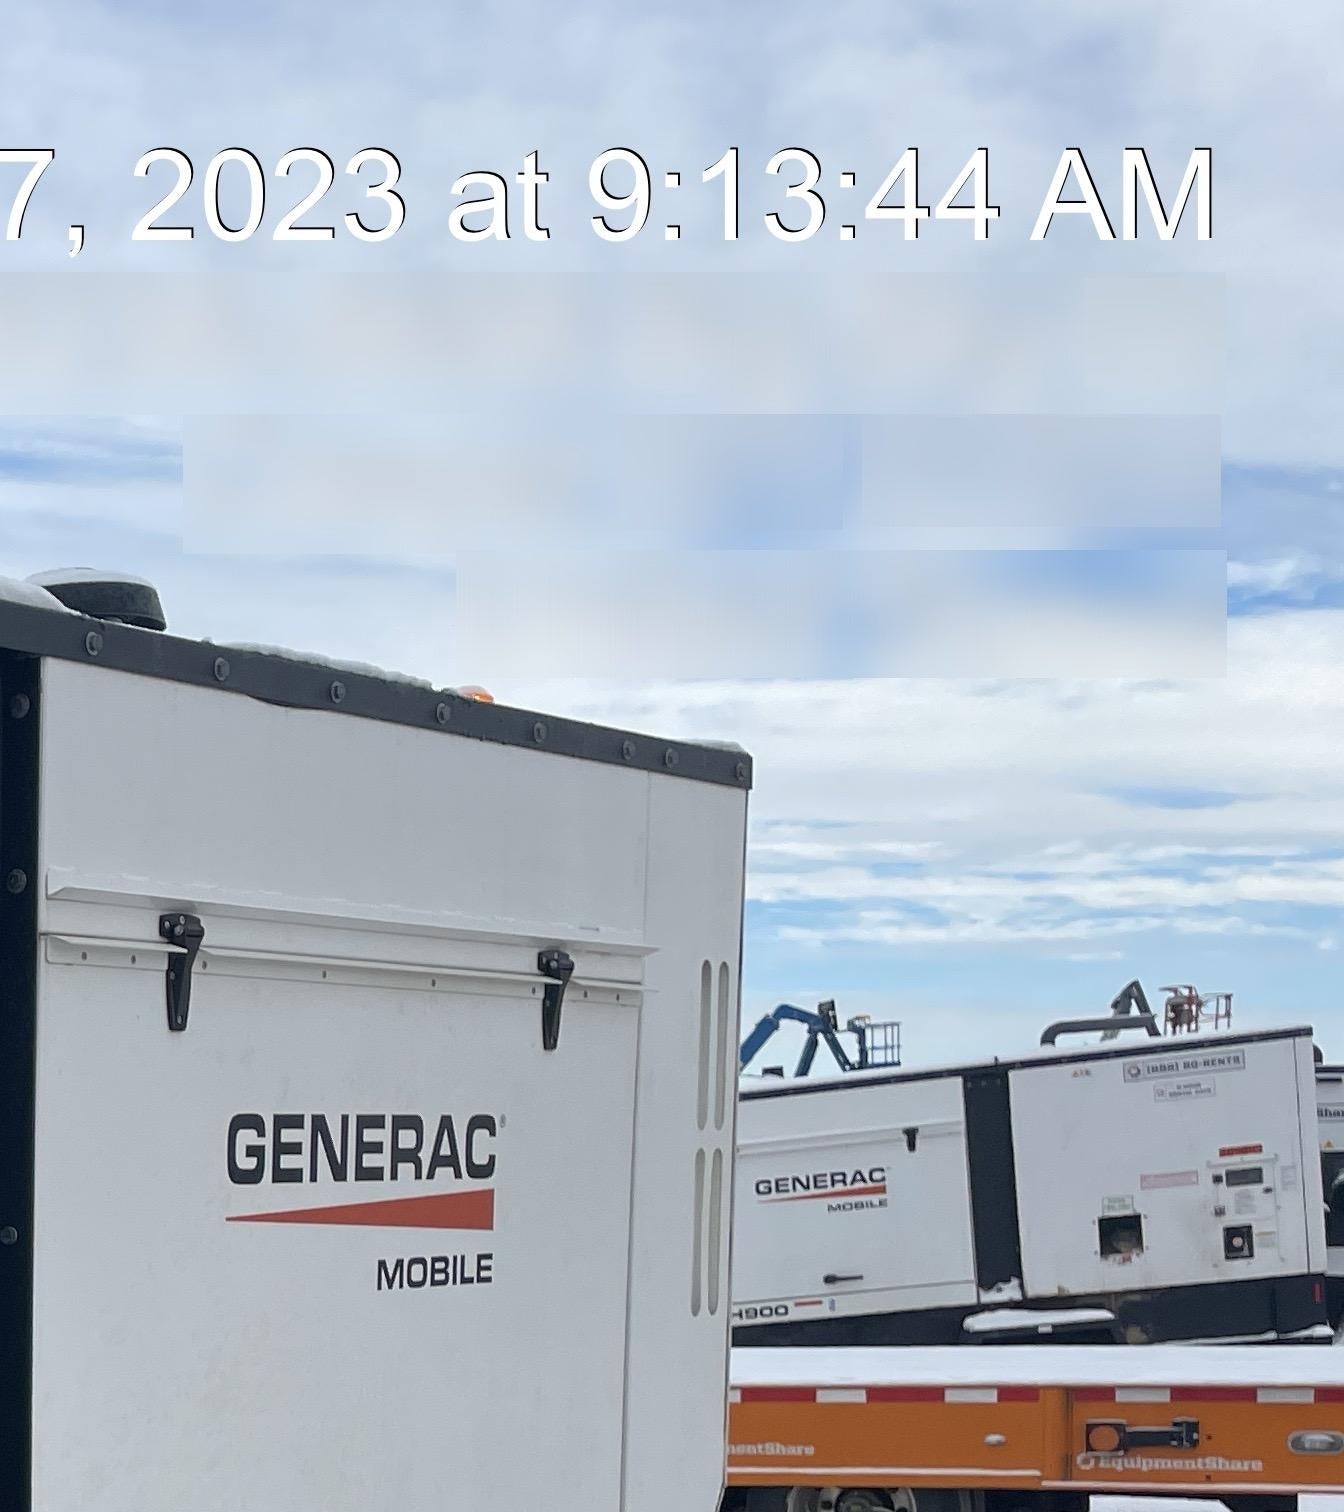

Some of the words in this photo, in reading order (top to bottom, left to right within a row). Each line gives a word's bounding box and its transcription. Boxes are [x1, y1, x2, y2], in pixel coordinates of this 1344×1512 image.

[227, 1113, 497, 1185] GENERAC
[755, 1167, 886, 1195] GENERAC
[827, 1198, 888, 1214] MOBILE
[377, 1253, 494, 1291] MOBILE
[1098, 1455, 1263, 1472] EquipmentShare
